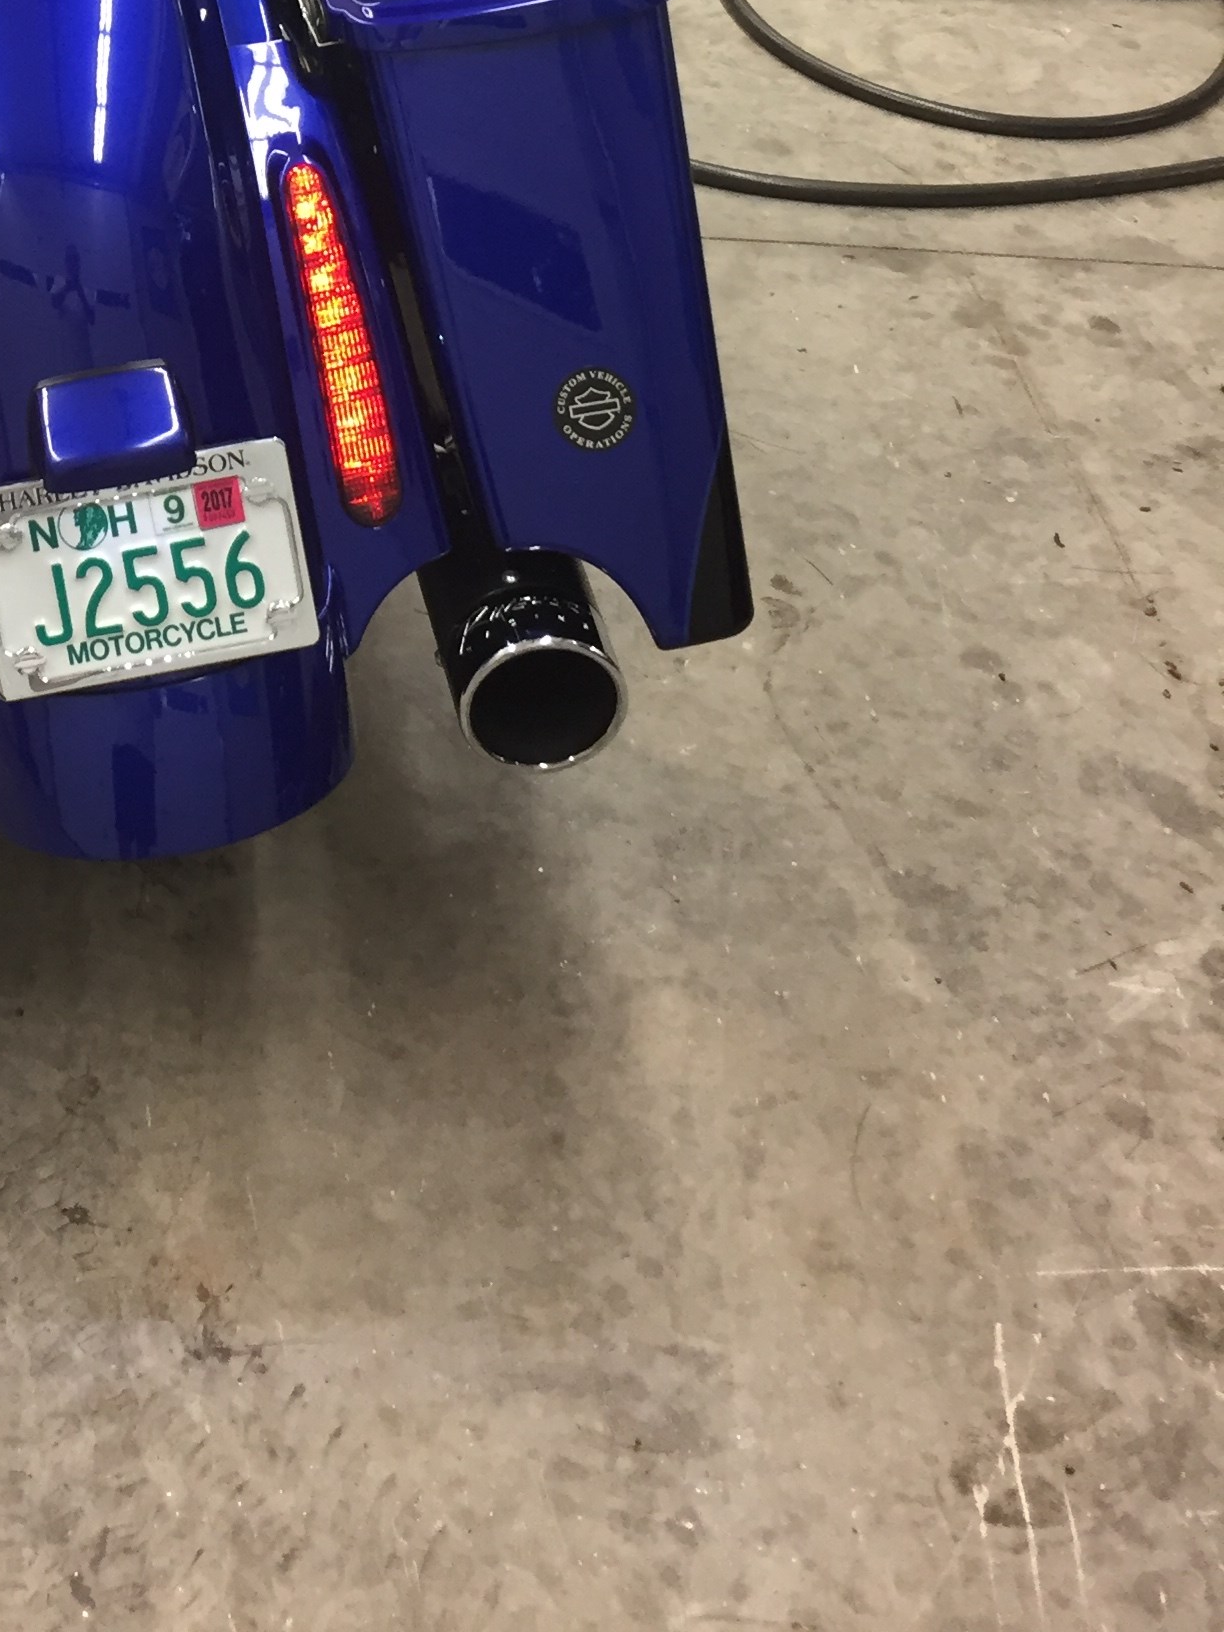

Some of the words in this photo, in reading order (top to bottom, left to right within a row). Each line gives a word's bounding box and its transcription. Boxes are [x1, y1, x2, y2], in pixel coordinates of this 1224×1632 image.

[557, 372, 587, 415] CUSTOM
[589, 370, 632, 405] VEHICLE
[563, 414, 633, 449] OPERATIONS
[163, 494, 185, 524] 9
[201, 487, 233, 512] 2017
[34, 529, 266, 648] J2556
[66, 612, 249, 666] MOTORCYCLE
